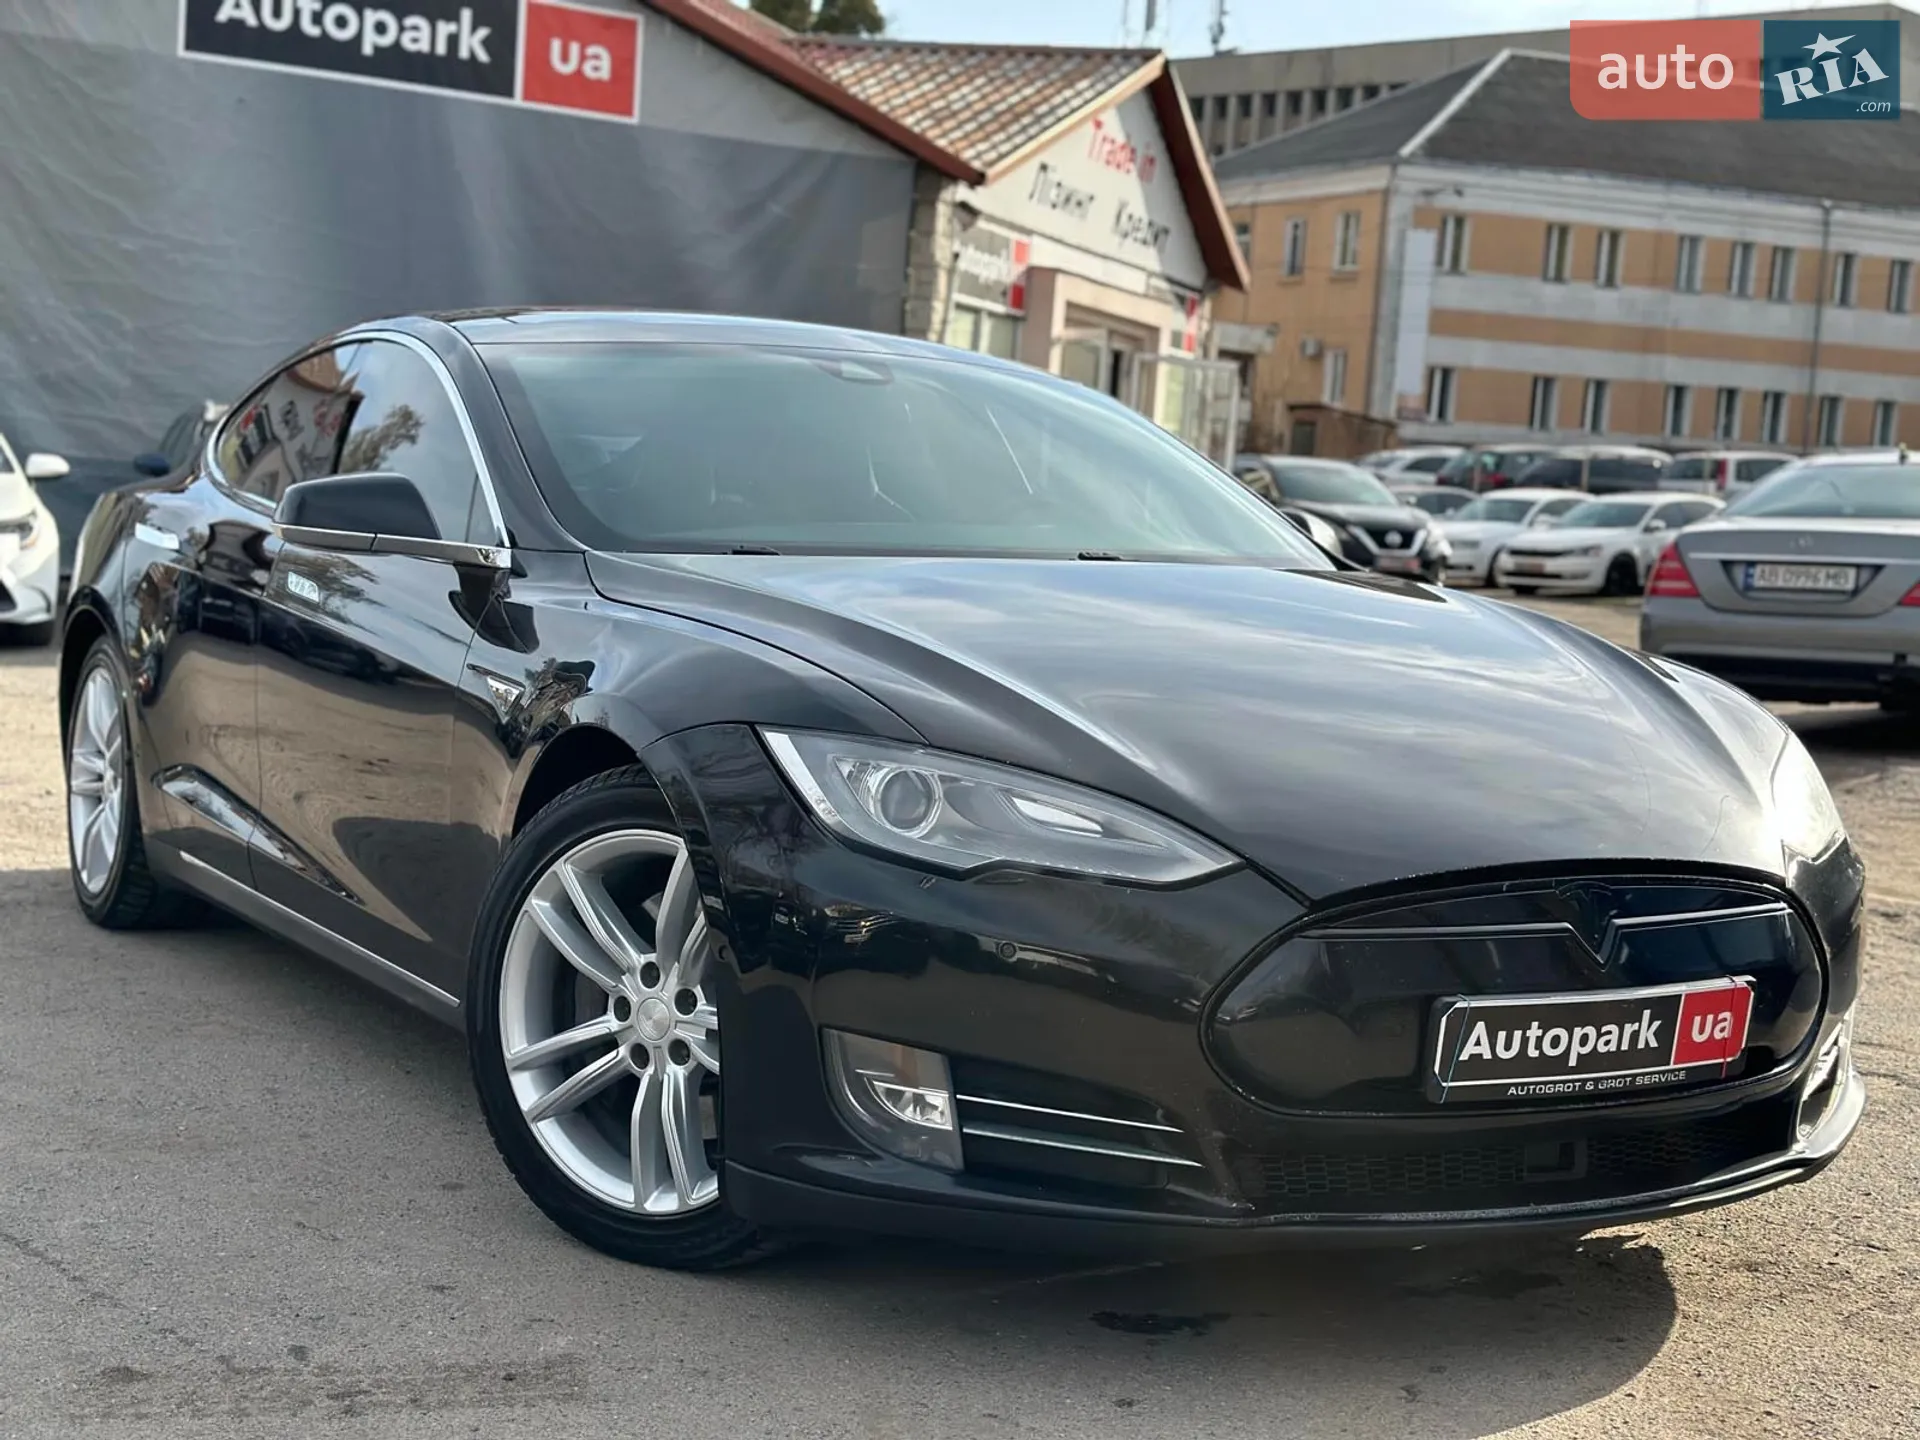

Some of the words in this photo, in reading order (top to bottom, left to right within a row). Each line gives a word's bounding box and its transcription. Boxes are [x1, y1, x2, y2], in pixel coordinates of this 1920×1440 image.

[549, 37, 612, 82] ua
[1459, 1009, 1662, 1067] Autopark
[1690, 1010, 1733, 1044] ua
[1507, 1082, 1581, 1096] AUTOGROT
[1585, 1081, 1595, 1091] &
[1636, 1070, 1687, 1085] SERVICE
